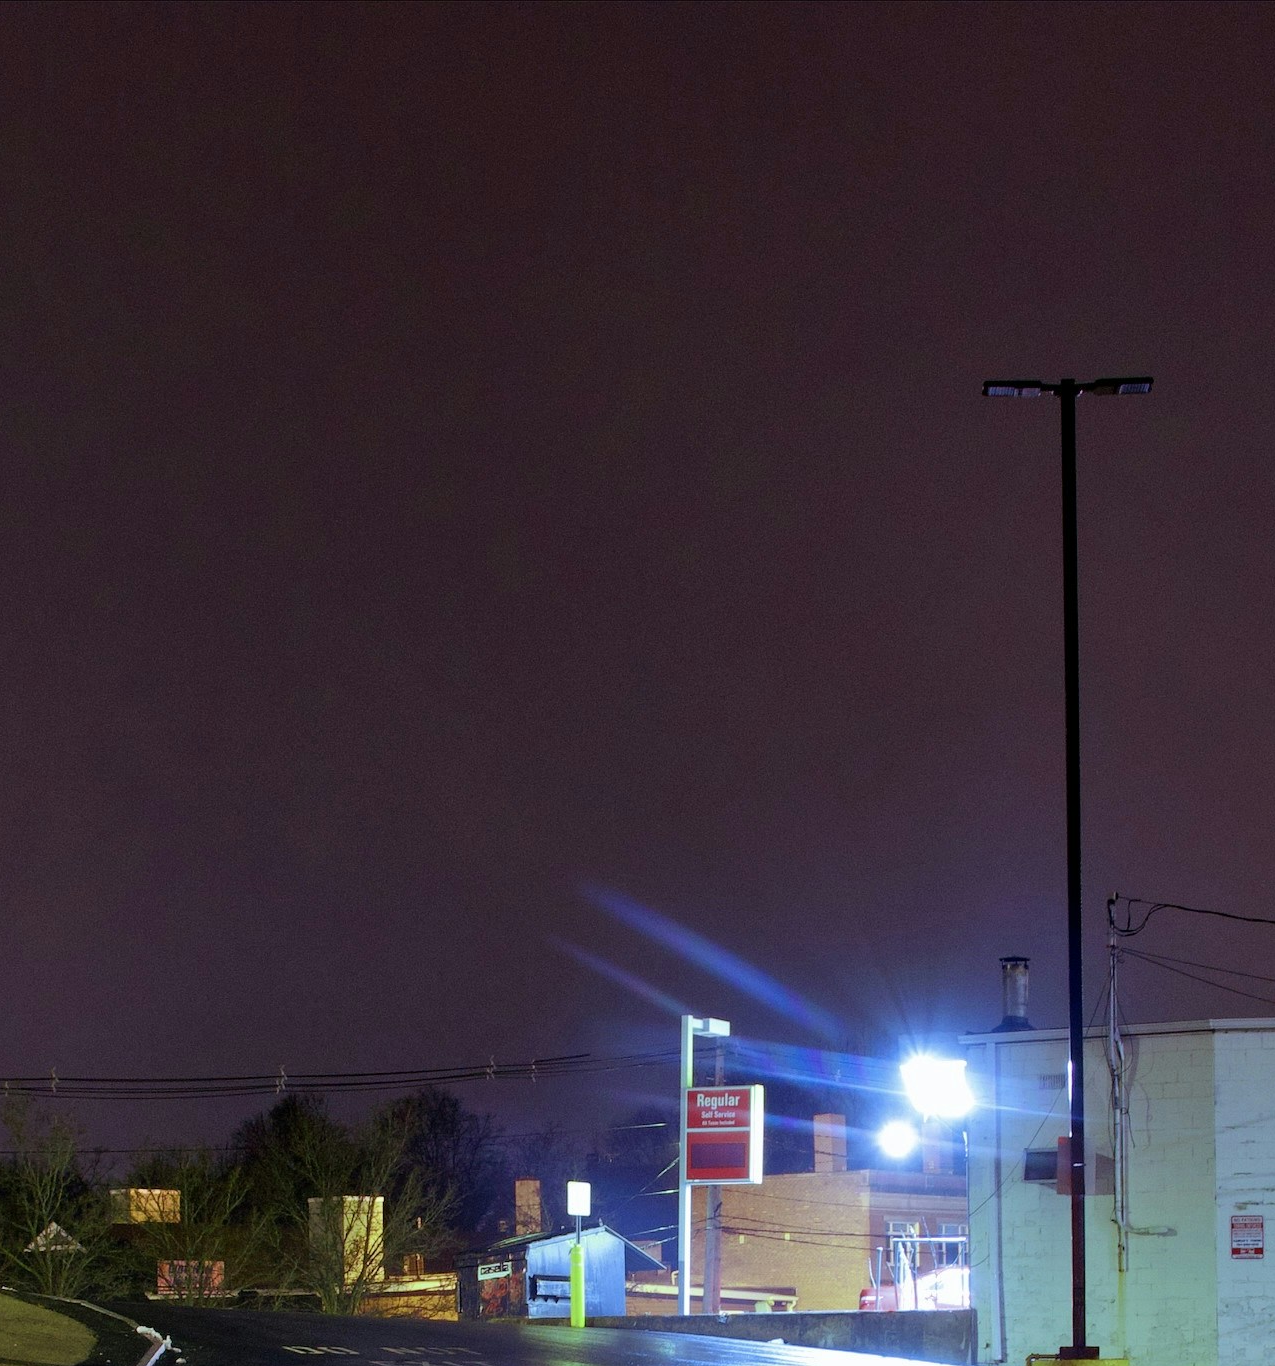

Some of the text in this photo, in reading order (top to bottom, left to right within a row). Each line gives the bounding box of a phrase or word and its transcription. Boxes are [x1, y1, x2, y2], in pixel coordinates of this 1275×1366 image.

[696, 1092, 741, 1110] Regular
[701, 1110, 736, 1119] Self Service
[282, 1345, 360, 1355] DO
